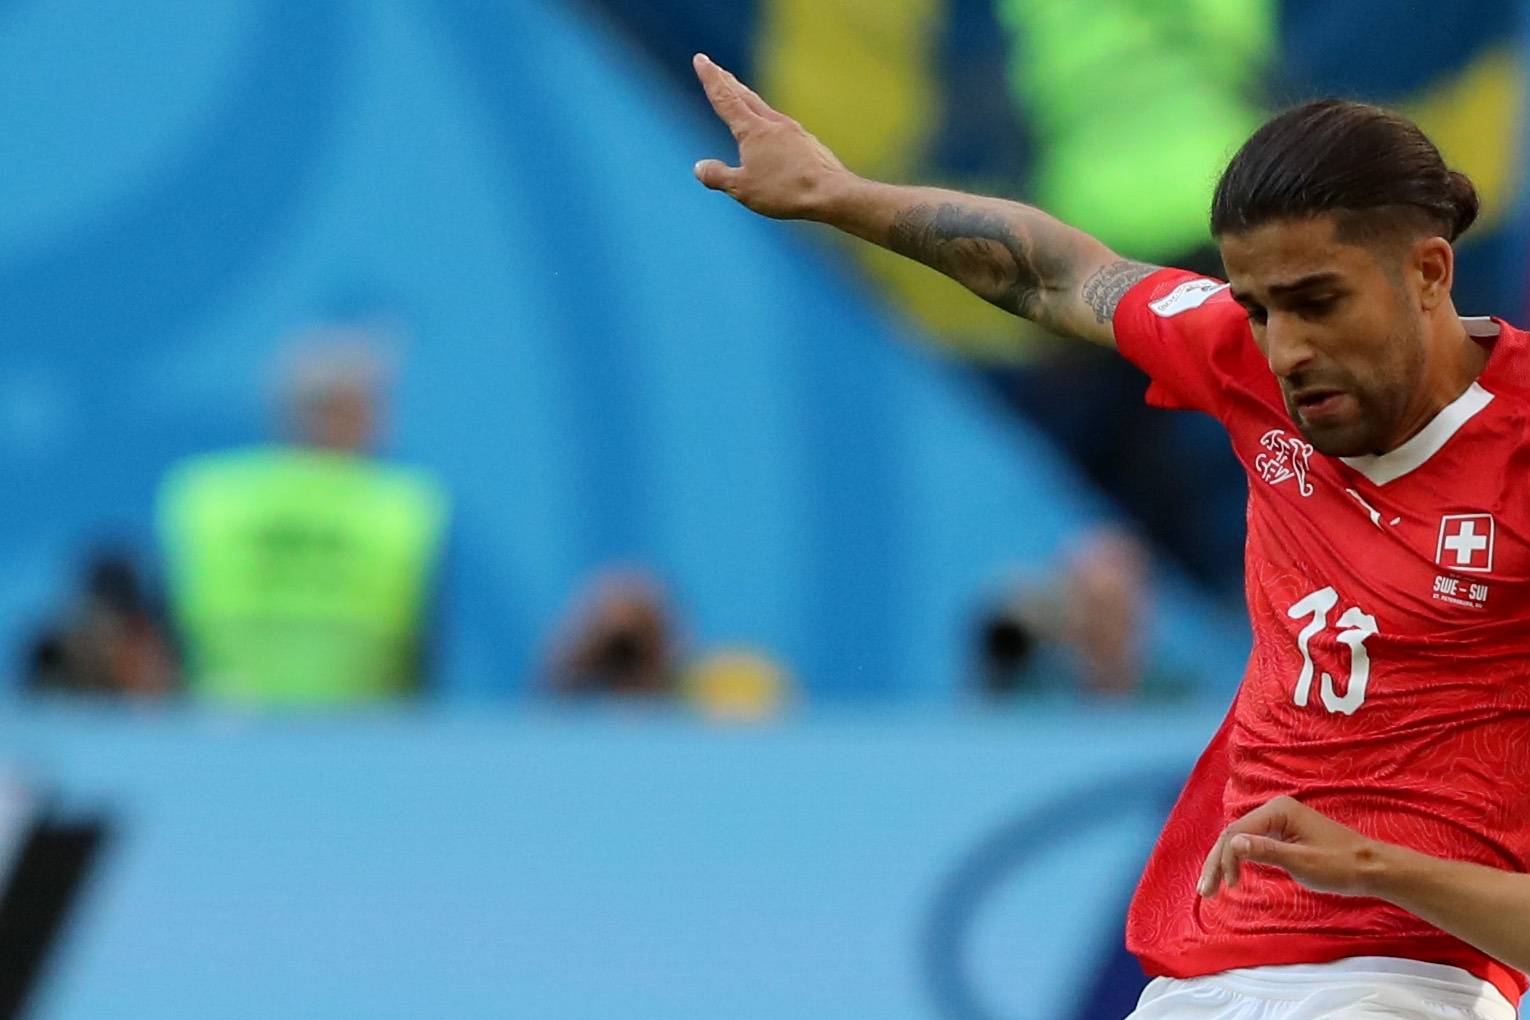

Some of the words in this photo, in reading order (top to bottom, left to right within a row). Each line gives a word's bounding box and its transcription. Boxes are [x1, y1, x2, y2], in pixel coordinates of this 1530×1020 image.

[1433, 575, 1459, 596] SWE
[1469, 583, 1488, 602] SUI
[1286, 585, 1381, 716] 13
